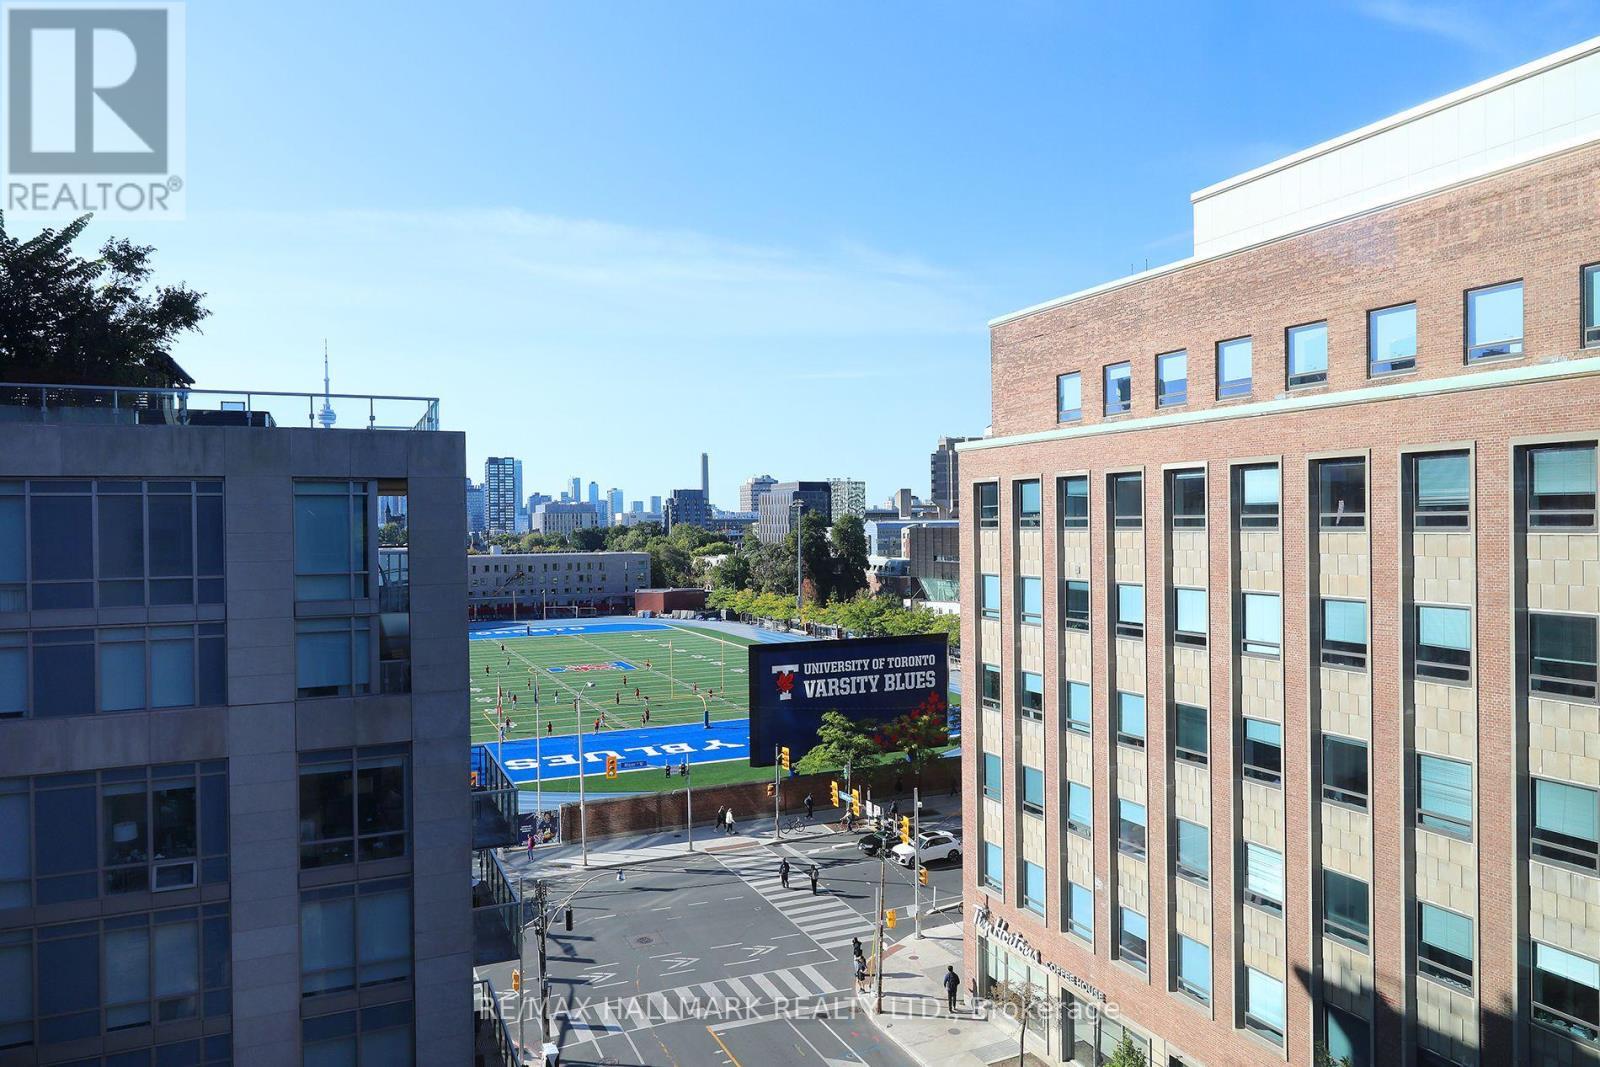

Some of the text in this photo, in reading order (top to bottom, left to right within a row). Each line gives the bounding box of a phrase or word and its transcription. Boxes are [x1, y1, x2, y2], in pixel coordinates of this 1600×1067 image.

[803, 654, 936, 675] UNIVERSITY OF TORONTO
[803, 670, 936, 699] VARSITY BLUES
